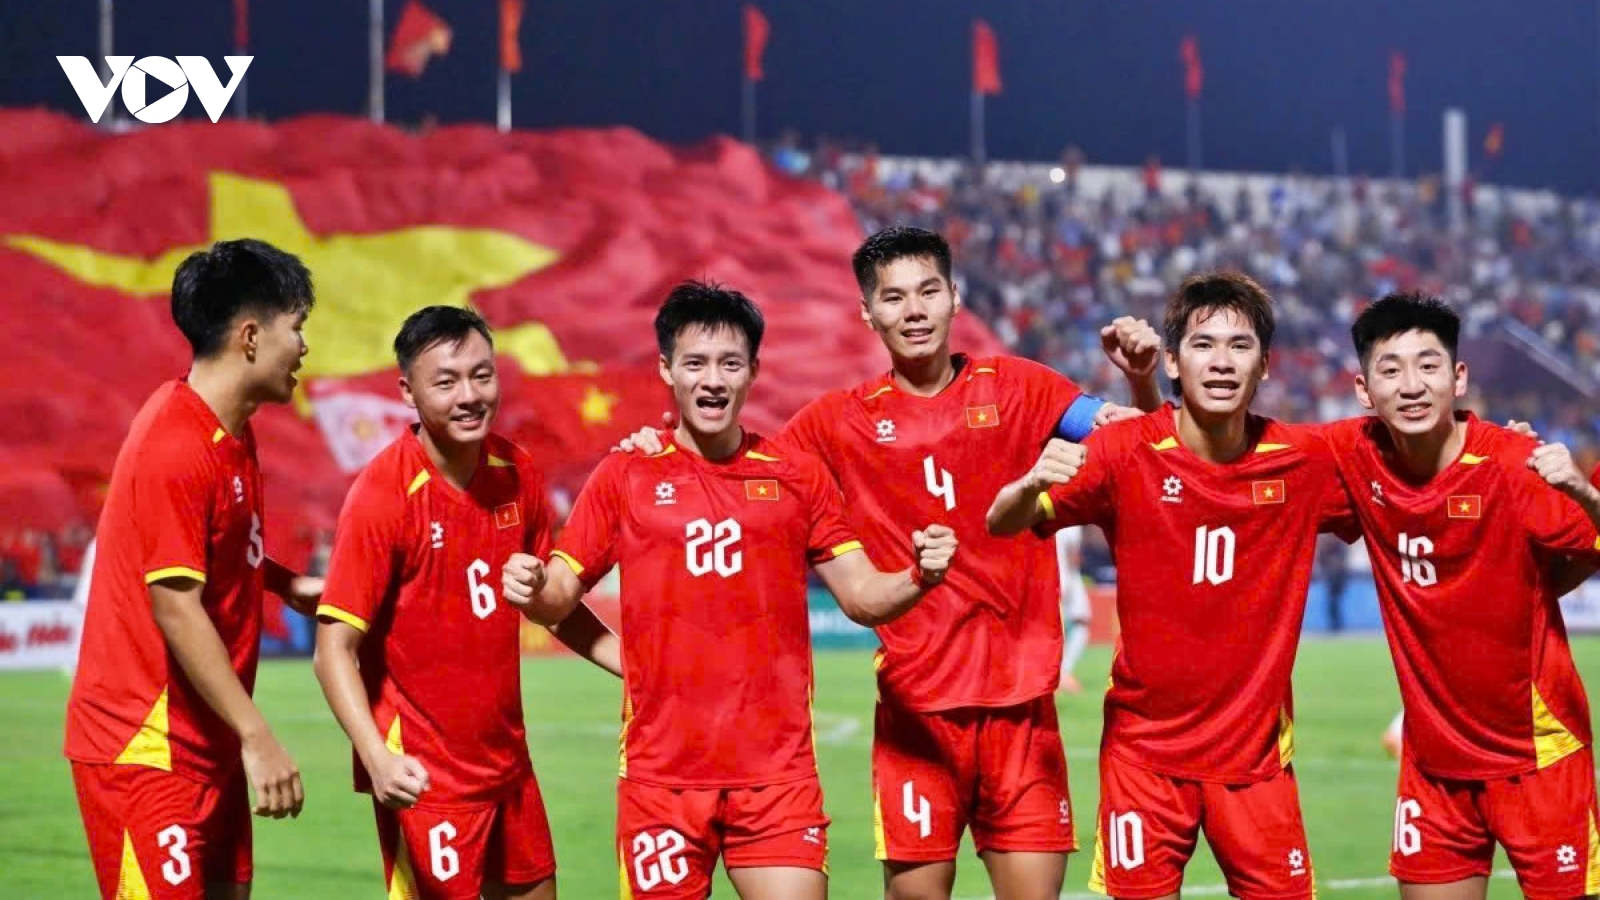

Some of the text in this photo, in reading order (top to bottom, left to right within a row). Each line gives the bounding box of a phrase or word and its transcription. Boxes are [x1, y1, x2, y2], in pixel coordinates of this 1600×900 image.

[923, 454, 957, 512] 4
[685, 518, 742, 578] 22
[1192, 525, 1236, 586] 10
[1398, 532, 1438, 587] 16
[467, 558, 497, 620] 6
[903, 780, 931, 839] 4
[1393, 796, 1422, 857] 16
[157, 824, 192, 886] 3
[428, 820, 460, 882] 6
[632, 829, 689, 892] 22
[1109, 811, 1145, 871] 10
